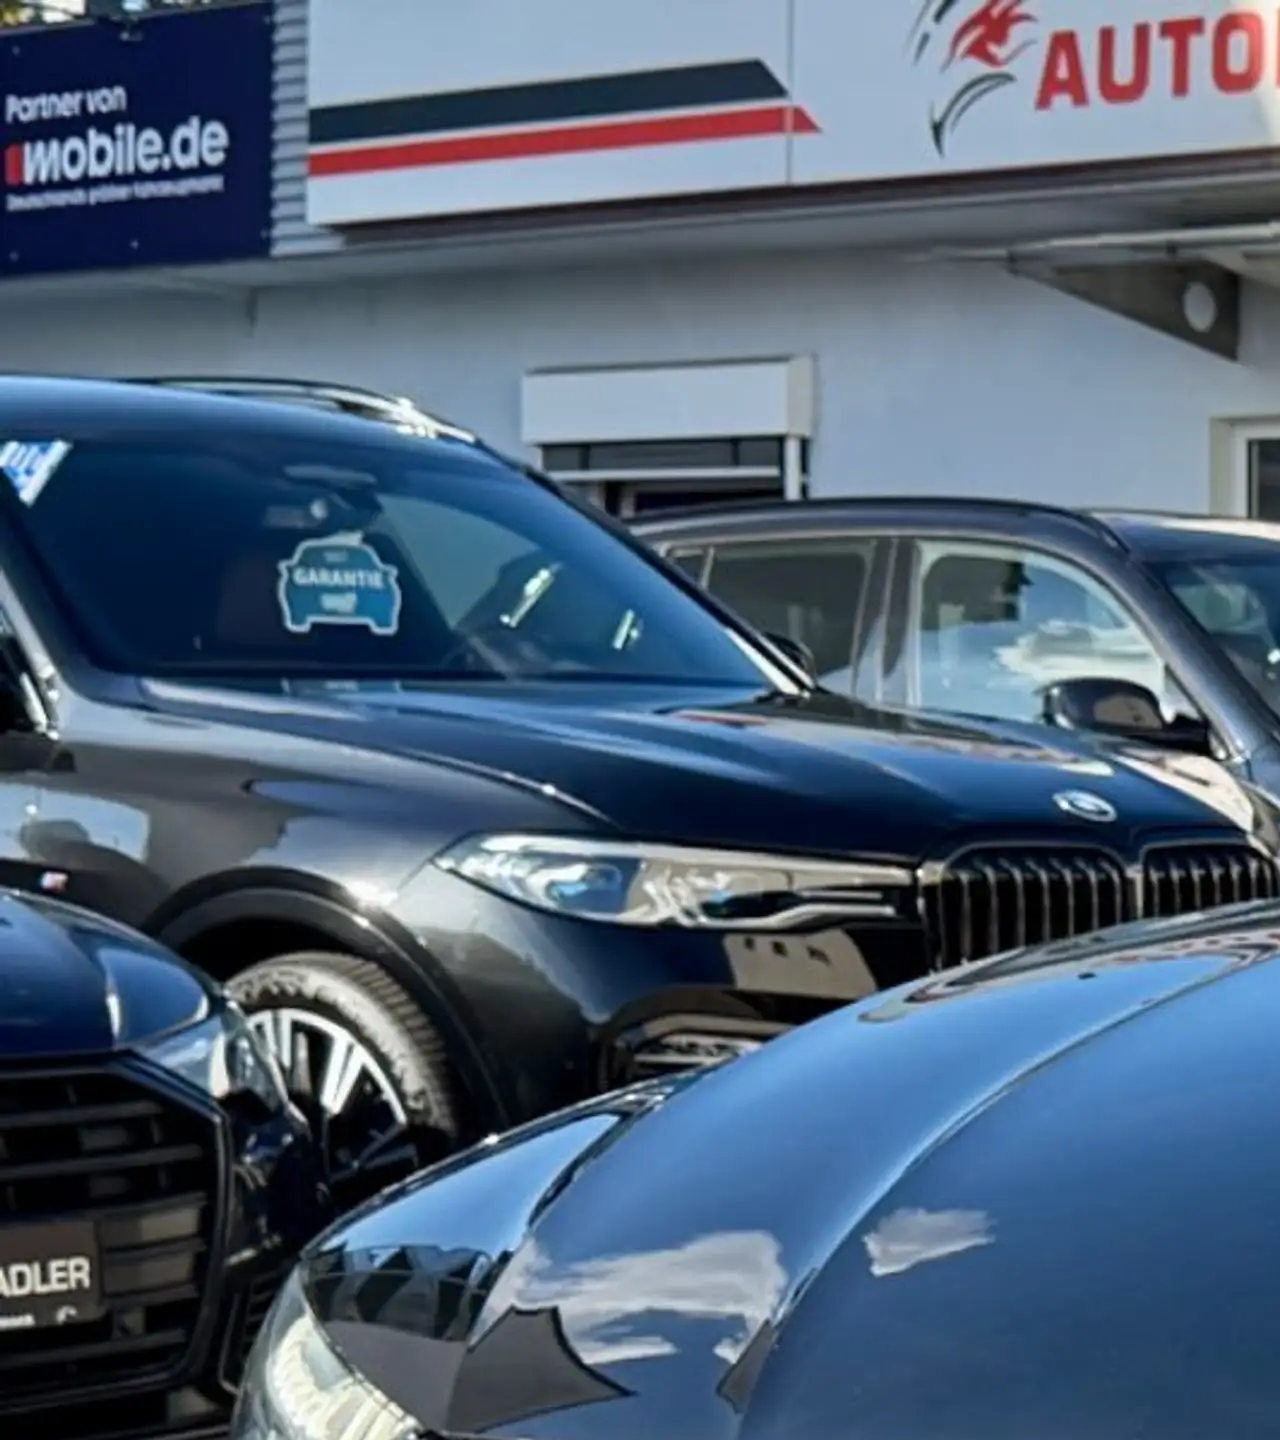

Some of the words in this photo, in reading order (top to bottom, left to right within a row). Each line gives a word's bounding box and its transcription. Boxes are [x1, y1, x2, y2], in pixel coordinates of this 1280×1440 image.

[6, 93, 82, 123] Partner
[87, 85, 127, 114] von
[23, 115, 230, 185] mobile.de
